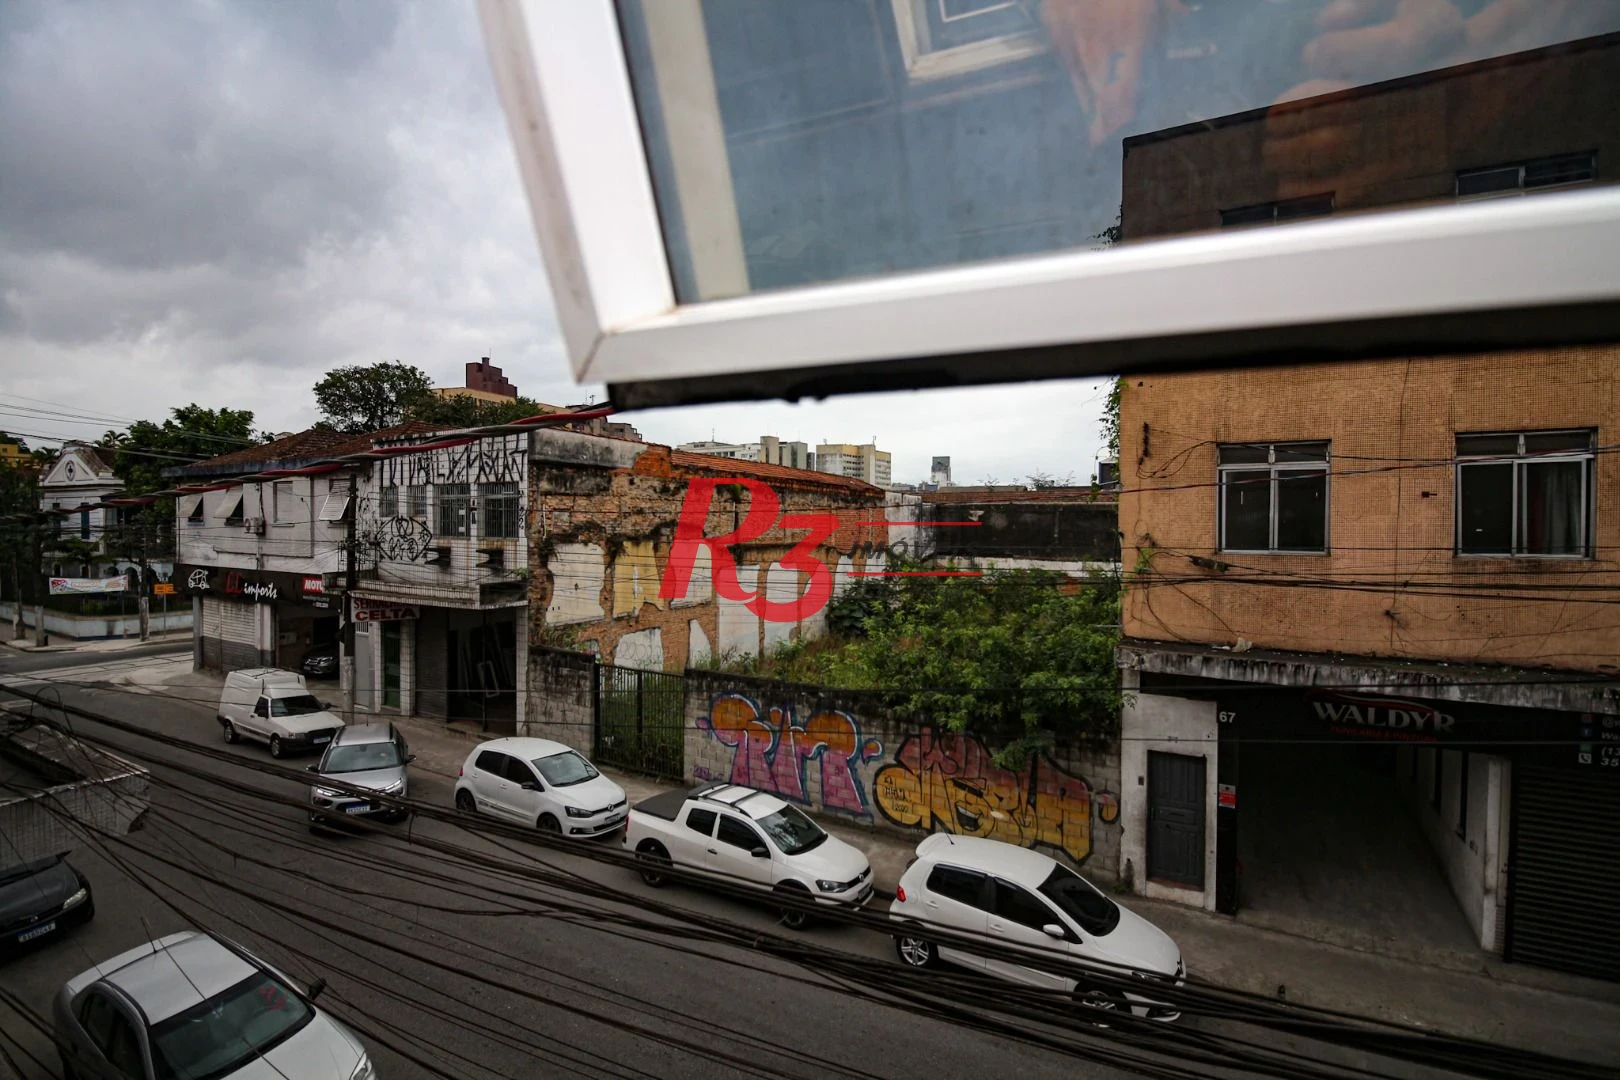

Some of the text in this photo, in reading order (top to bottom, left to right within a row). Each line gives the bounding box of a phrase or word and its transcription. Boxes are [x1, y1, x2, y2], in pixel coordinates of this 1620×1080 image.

[355, 607, 415, 621] CELTA
[1218, 711, 1236, 723] 67
[1311, 701, 1456, 733] WALDYR
